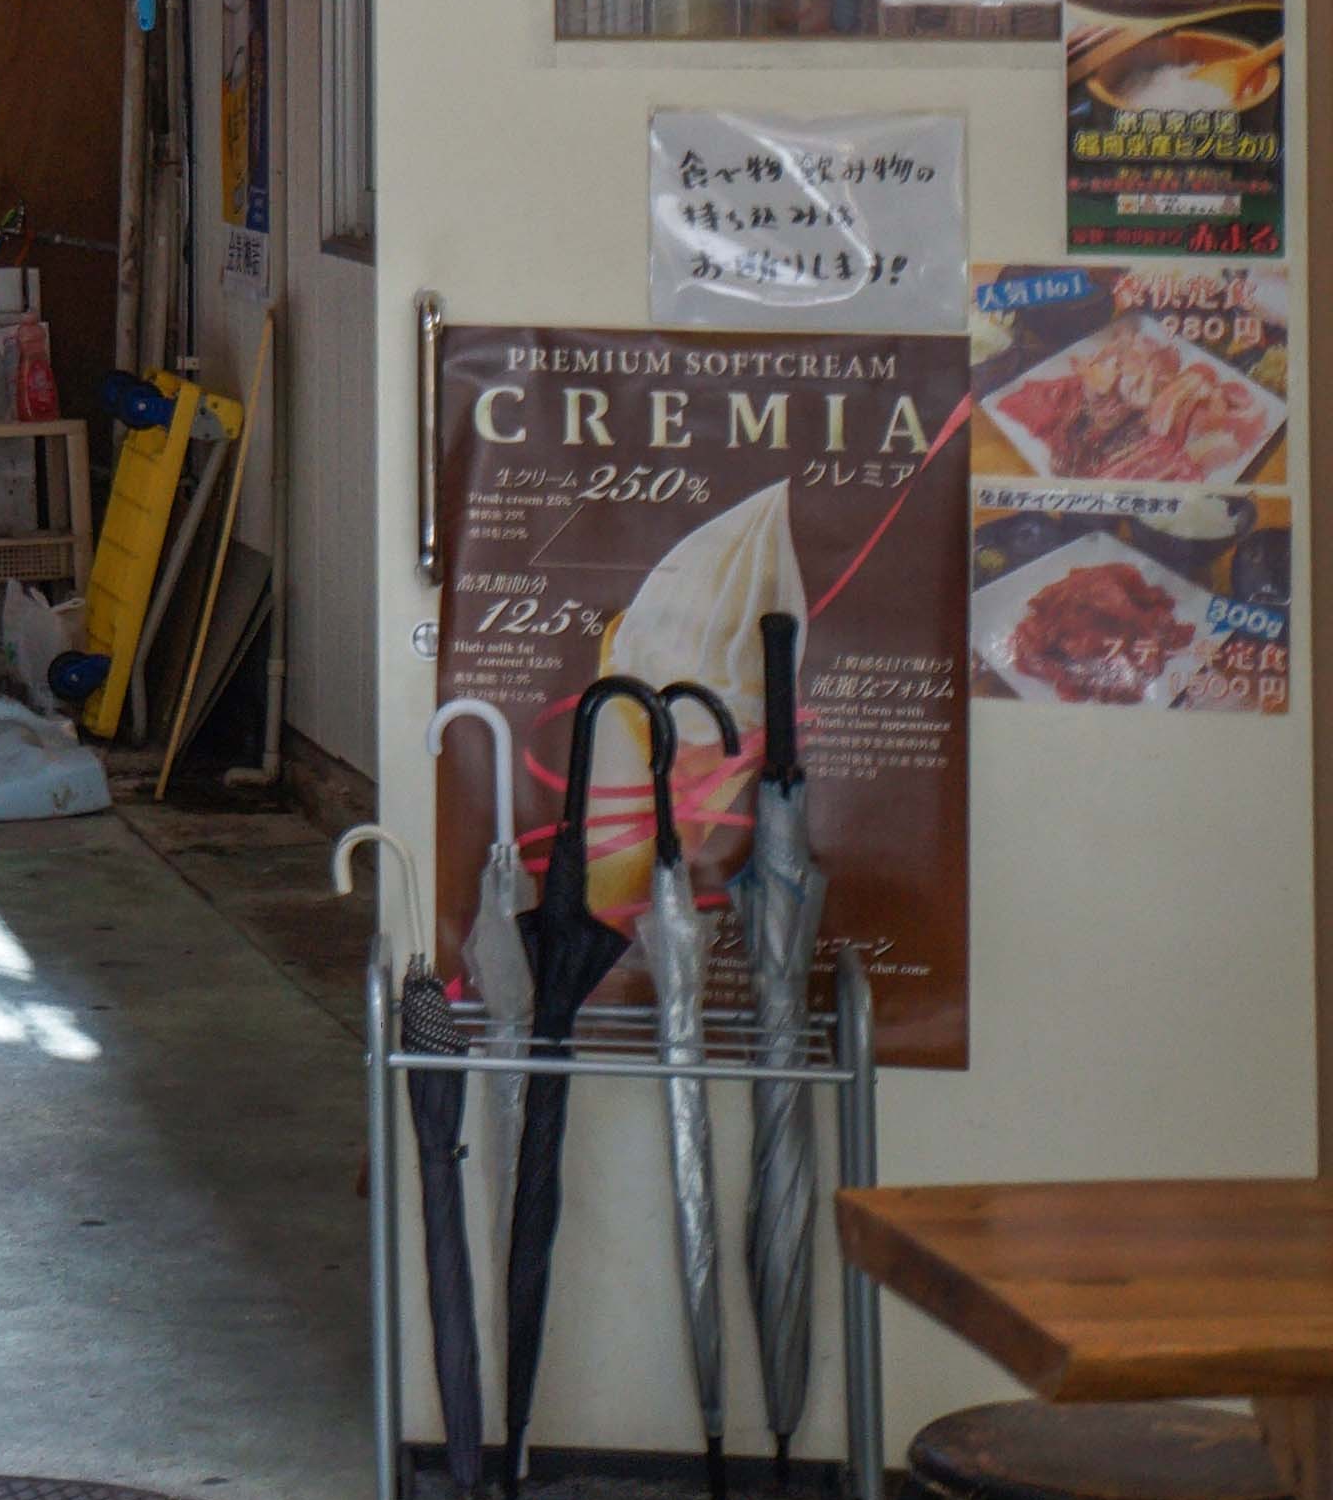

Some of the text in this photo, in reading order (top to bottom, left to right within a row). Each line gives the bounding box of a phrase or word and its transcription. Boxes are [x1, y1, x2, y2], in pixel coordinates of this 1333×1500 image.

[507, 348, 898, 381] PREMIUM SOFTCREAM
[473, 384, 932, 454] CREMIA
[494, 464, 711, 505] 生クリーム 25.0%
[802, 458, 919, 489] クレミア
[476, 597, 605, 637] 12.5%
